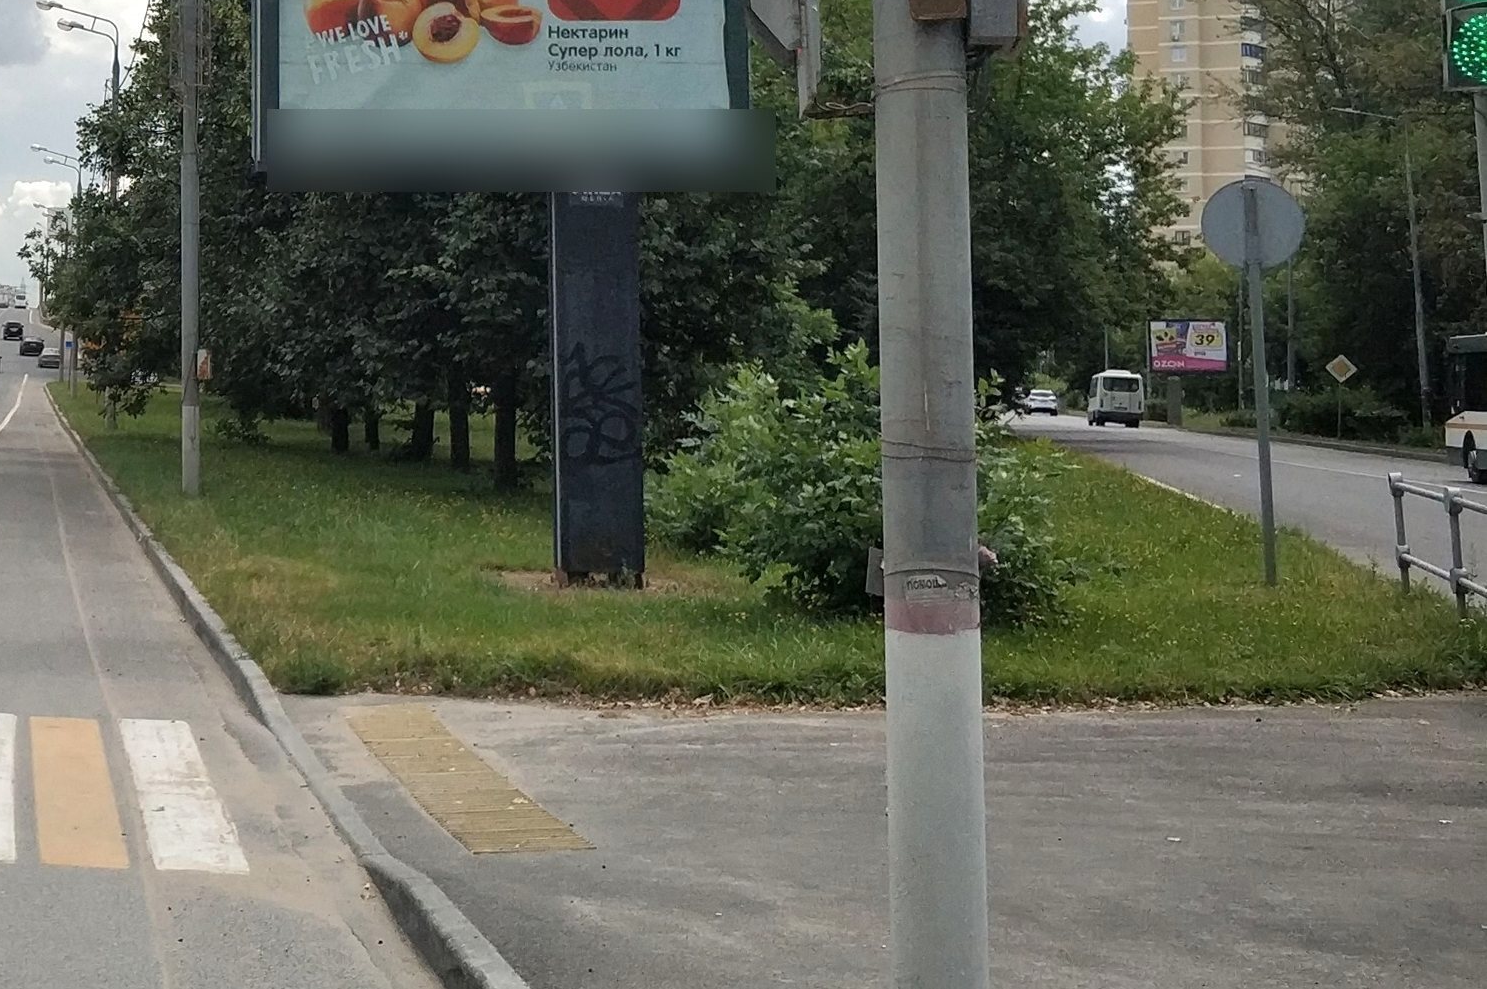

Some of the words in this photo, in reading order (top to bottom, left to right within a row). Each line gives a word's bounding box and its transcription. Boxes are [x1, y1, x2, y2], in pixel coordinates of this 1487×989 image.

[316, 27, 346, 48] WE
[348, 14, 392, 42] LOVE
[548, 25, 629, 42] Нектарин
[307, 33, 402, 85] FRESH
[548, 43, 598, 60] Супер
[603, 46, 648, 58] лола,
[654, 44, 660, 57] 1
[666, 46, 681, 57] кг
[548, 60, 617, 72] Узбекистан
[1194, 334, 1215, 346] 39
[1154, 360, 1185, 368] OZON
